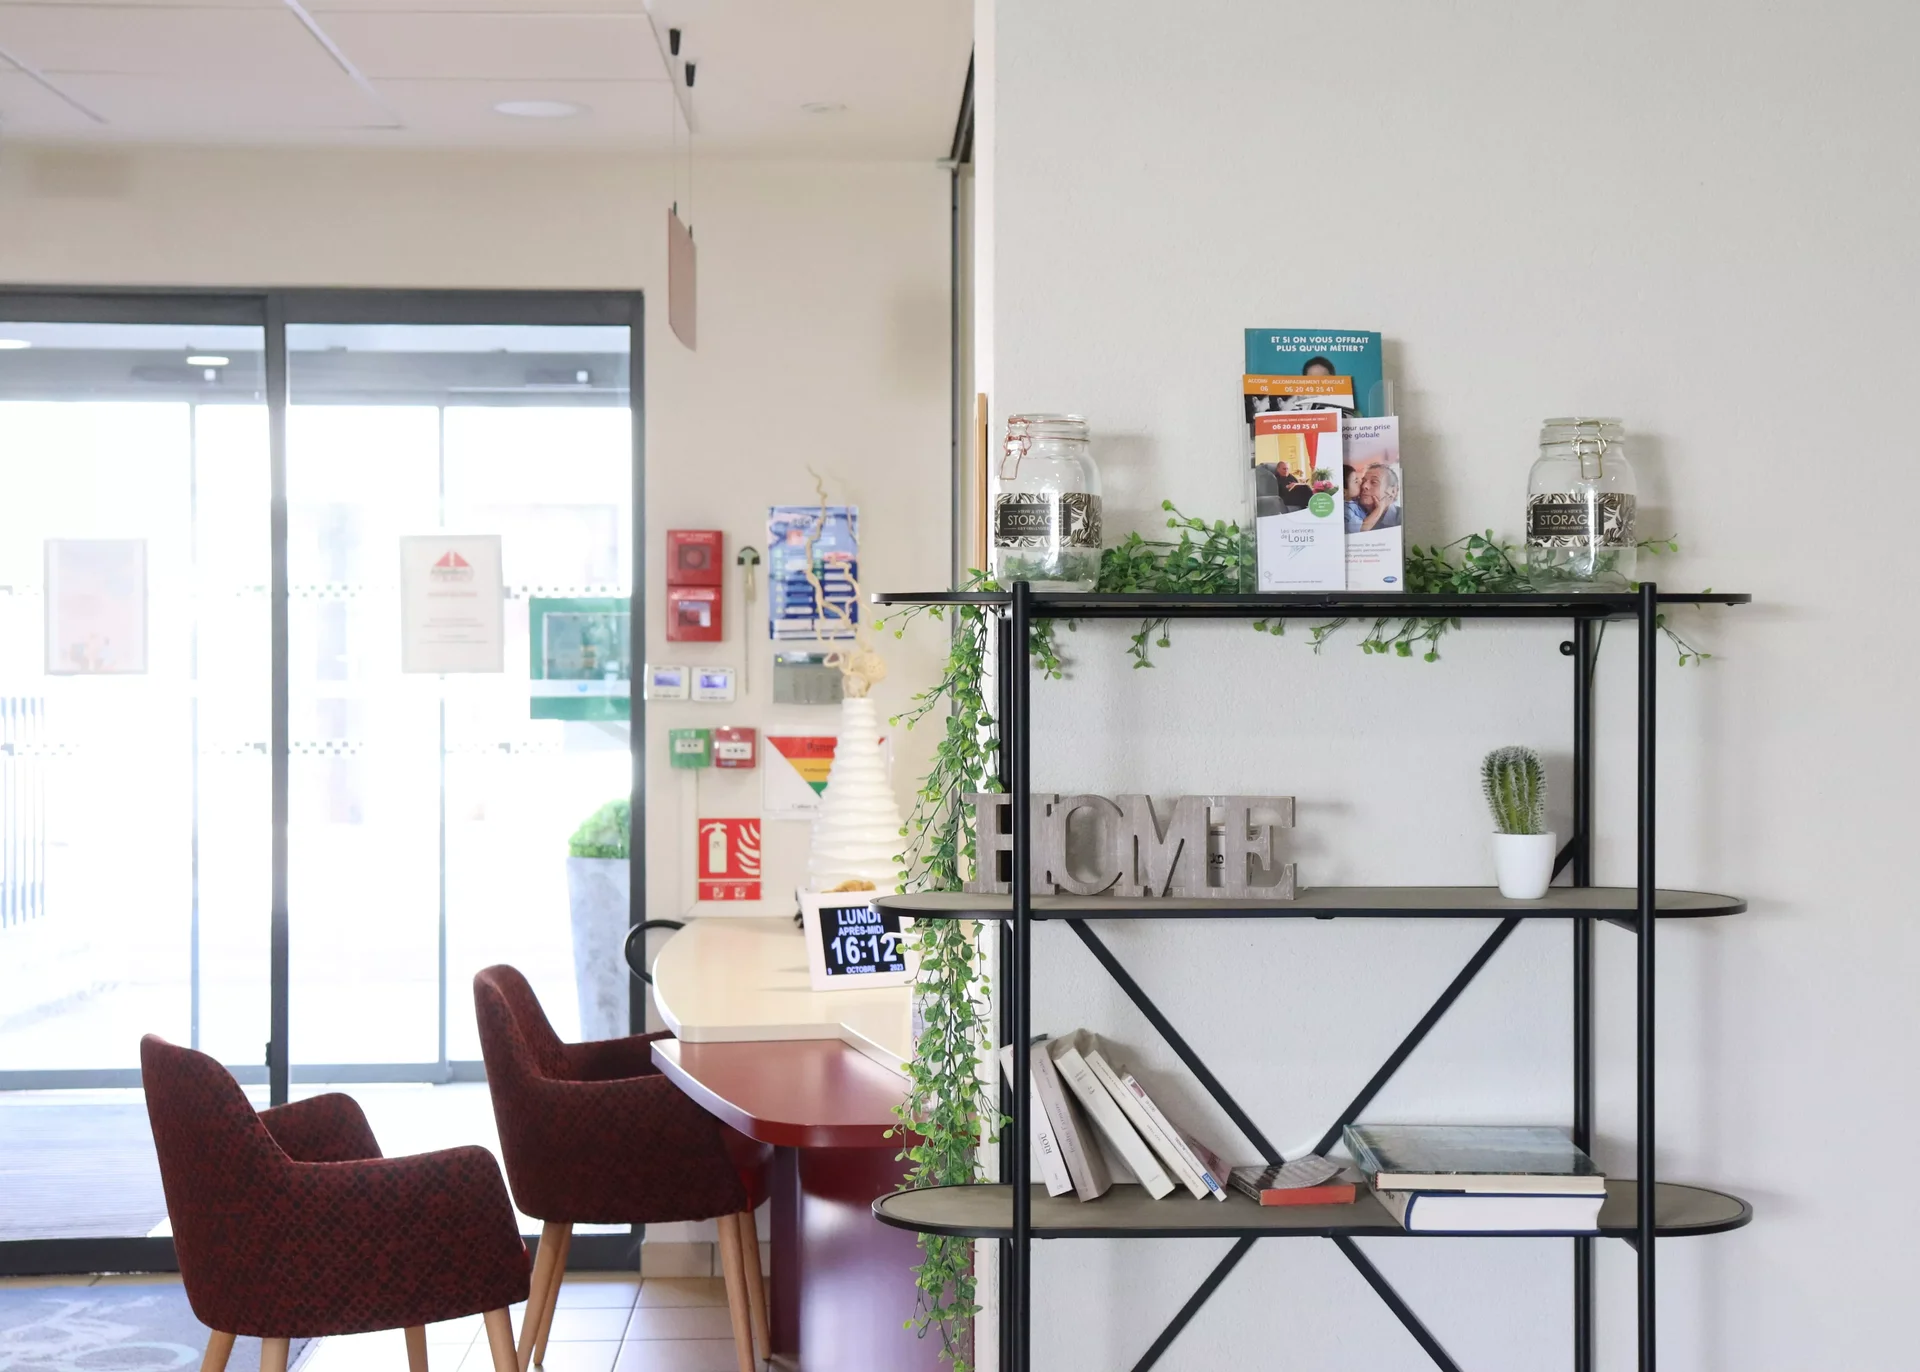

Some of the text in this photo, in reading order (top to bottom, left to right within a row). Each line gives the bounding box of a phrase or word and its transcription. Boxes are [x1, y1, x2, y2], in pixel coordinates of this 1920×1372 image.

[1271, 336, 1370, 344] ET SI ON VOUS OFFRAIT
[1354, 431, 1380, 440] globale
[1288, 534, 1315, 543] Louis
[963, 792, 1296, 900] HOME
[836, 907, 882, 925] LUNDI
[838, 924, 885, 937] APRÈS-MIDI
[830, 935, 898, 965] 16:12
[846, 964, 877, 975] OCTOBRE
[890, 963, 904, 972] 2023
[1040, 1132, 1052, 1154] RIOU
[1202, 1173, 1218, 1191] POCKET
